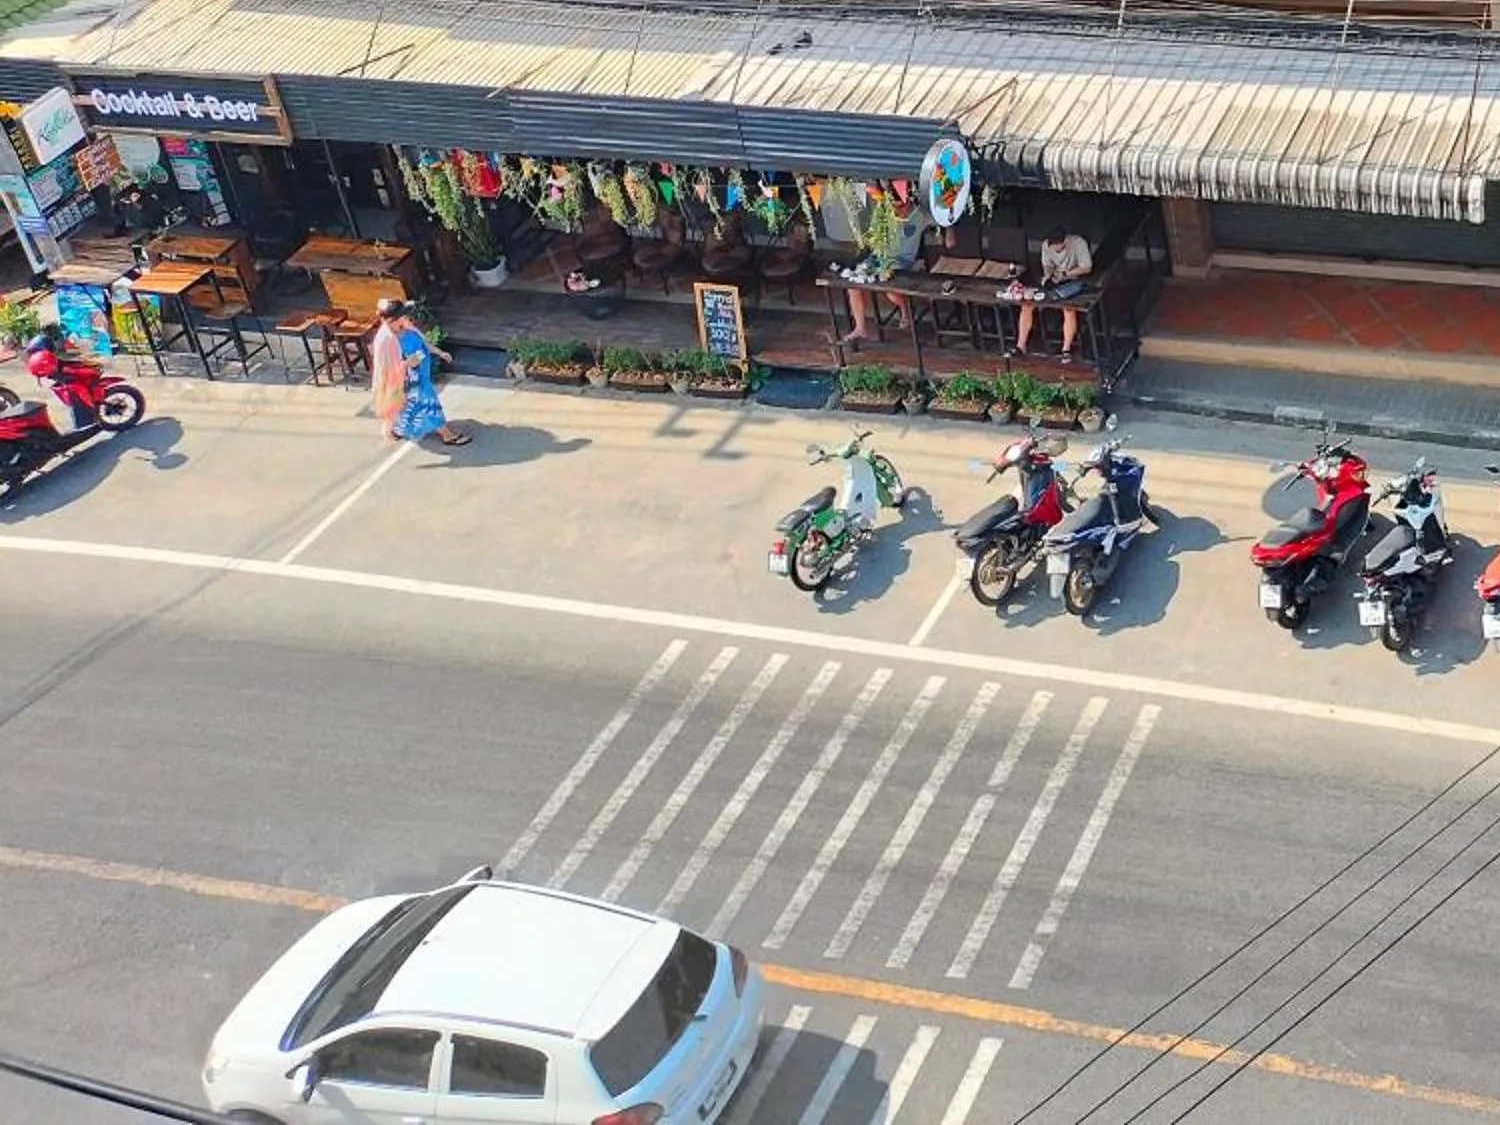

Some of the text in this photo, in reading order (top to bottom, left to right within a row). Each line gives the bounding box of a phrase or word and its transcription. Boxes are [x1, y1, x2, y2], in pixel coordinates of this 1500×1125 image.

[91, 88, 258, 122] Cocktail & Beer
